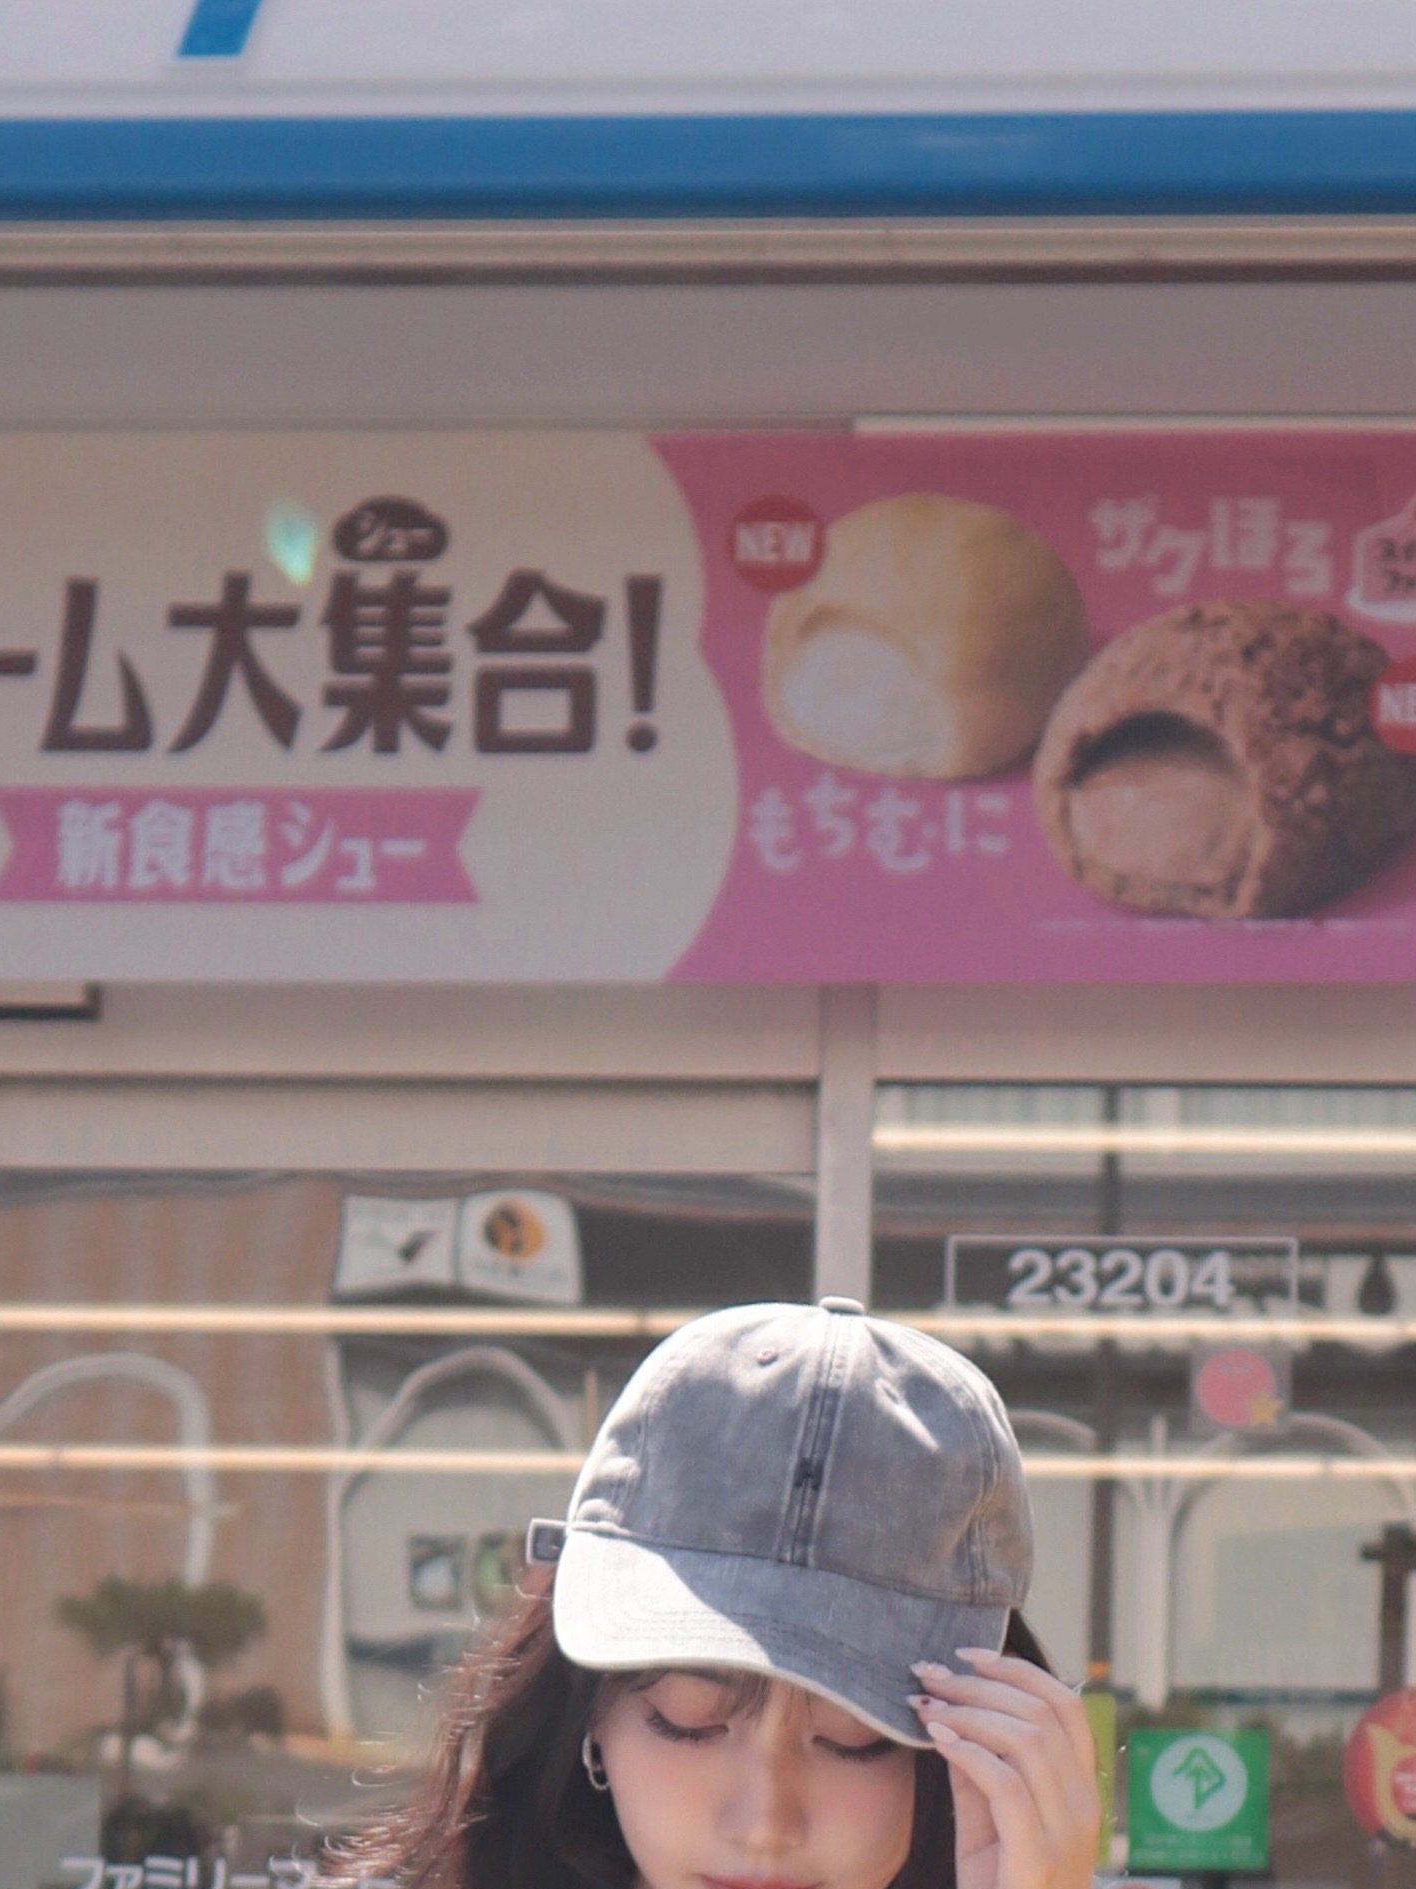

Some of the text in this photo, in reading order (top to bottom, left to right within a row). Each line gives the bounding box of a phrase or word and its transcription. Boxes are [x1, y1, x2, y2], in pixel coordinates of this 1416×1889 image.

[733, 516, 814, 567] NEW
[1090, 495, 1334, 597] ザクほろ
[55, 799, 426, 894] 新食感シュー
[747, 771, 1013, 876] もちむに
[1006, 1248, 1237, 1306] 23204
